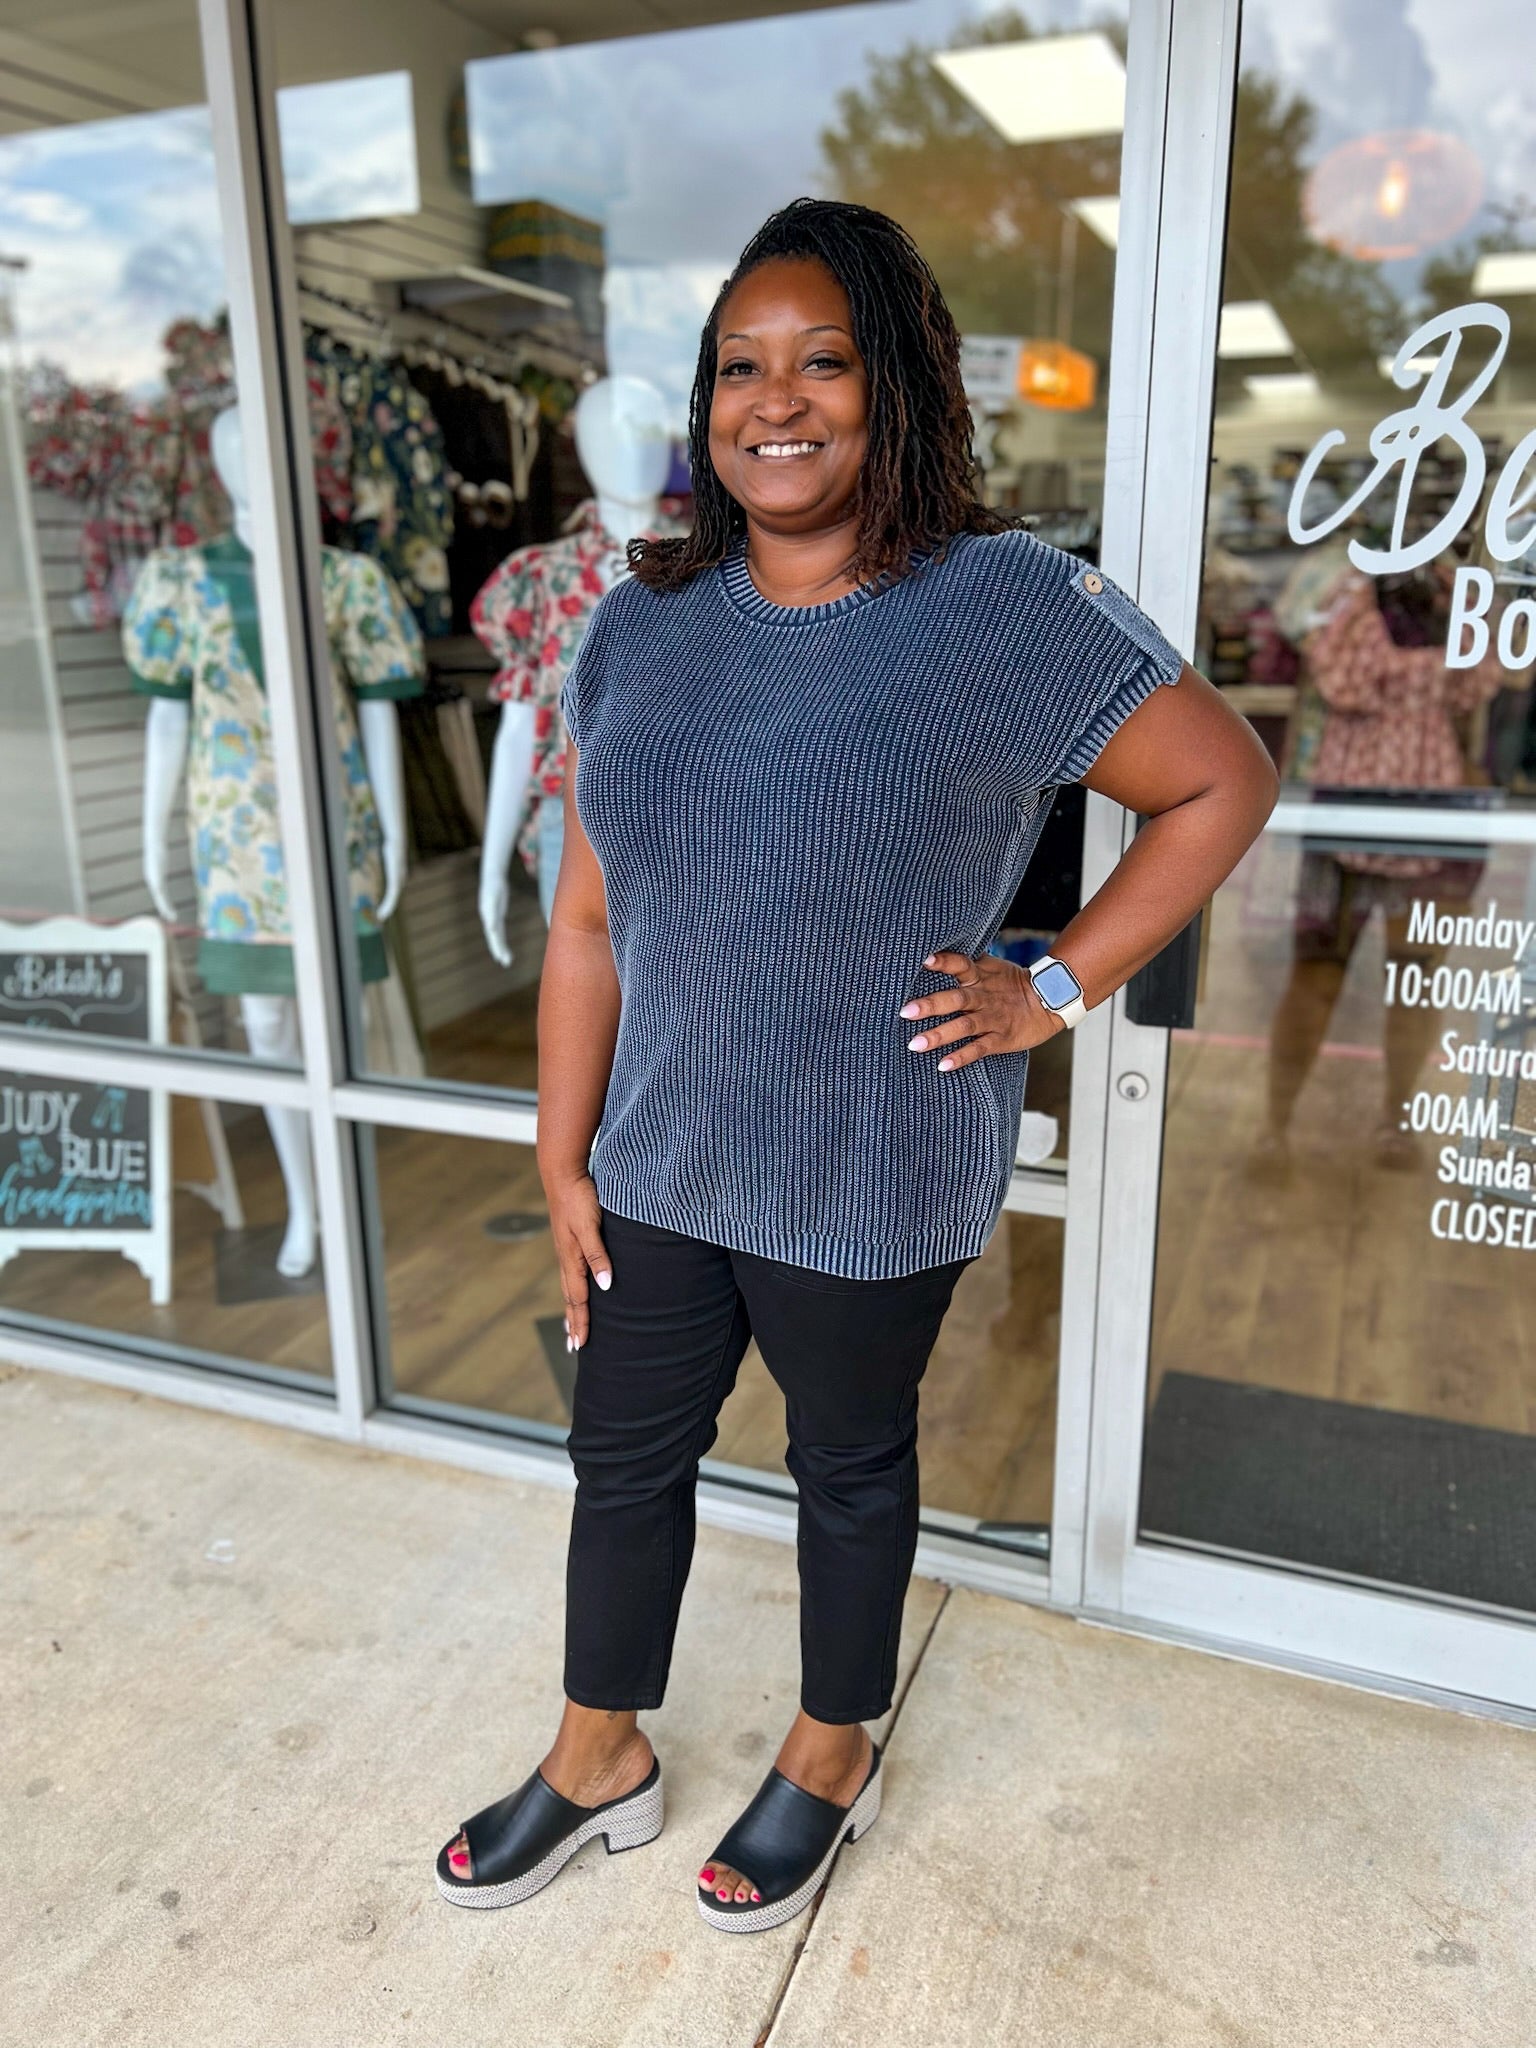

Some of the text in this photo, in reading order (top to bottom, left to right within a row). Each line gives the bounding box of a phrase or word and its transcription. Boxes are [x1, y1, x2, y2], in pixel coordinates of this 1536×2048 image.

[1445, 566, 1536, 670] Bo
[1407, 901, 1536, 961] Monday
[1385, 961, 1534, 1016] 10:00AM-
[0, 1086, 80, 1135] JUDY
[60, 1133, 146, 1181] BLUE
[1430, 1198, 1536, 1249] CLOSED
